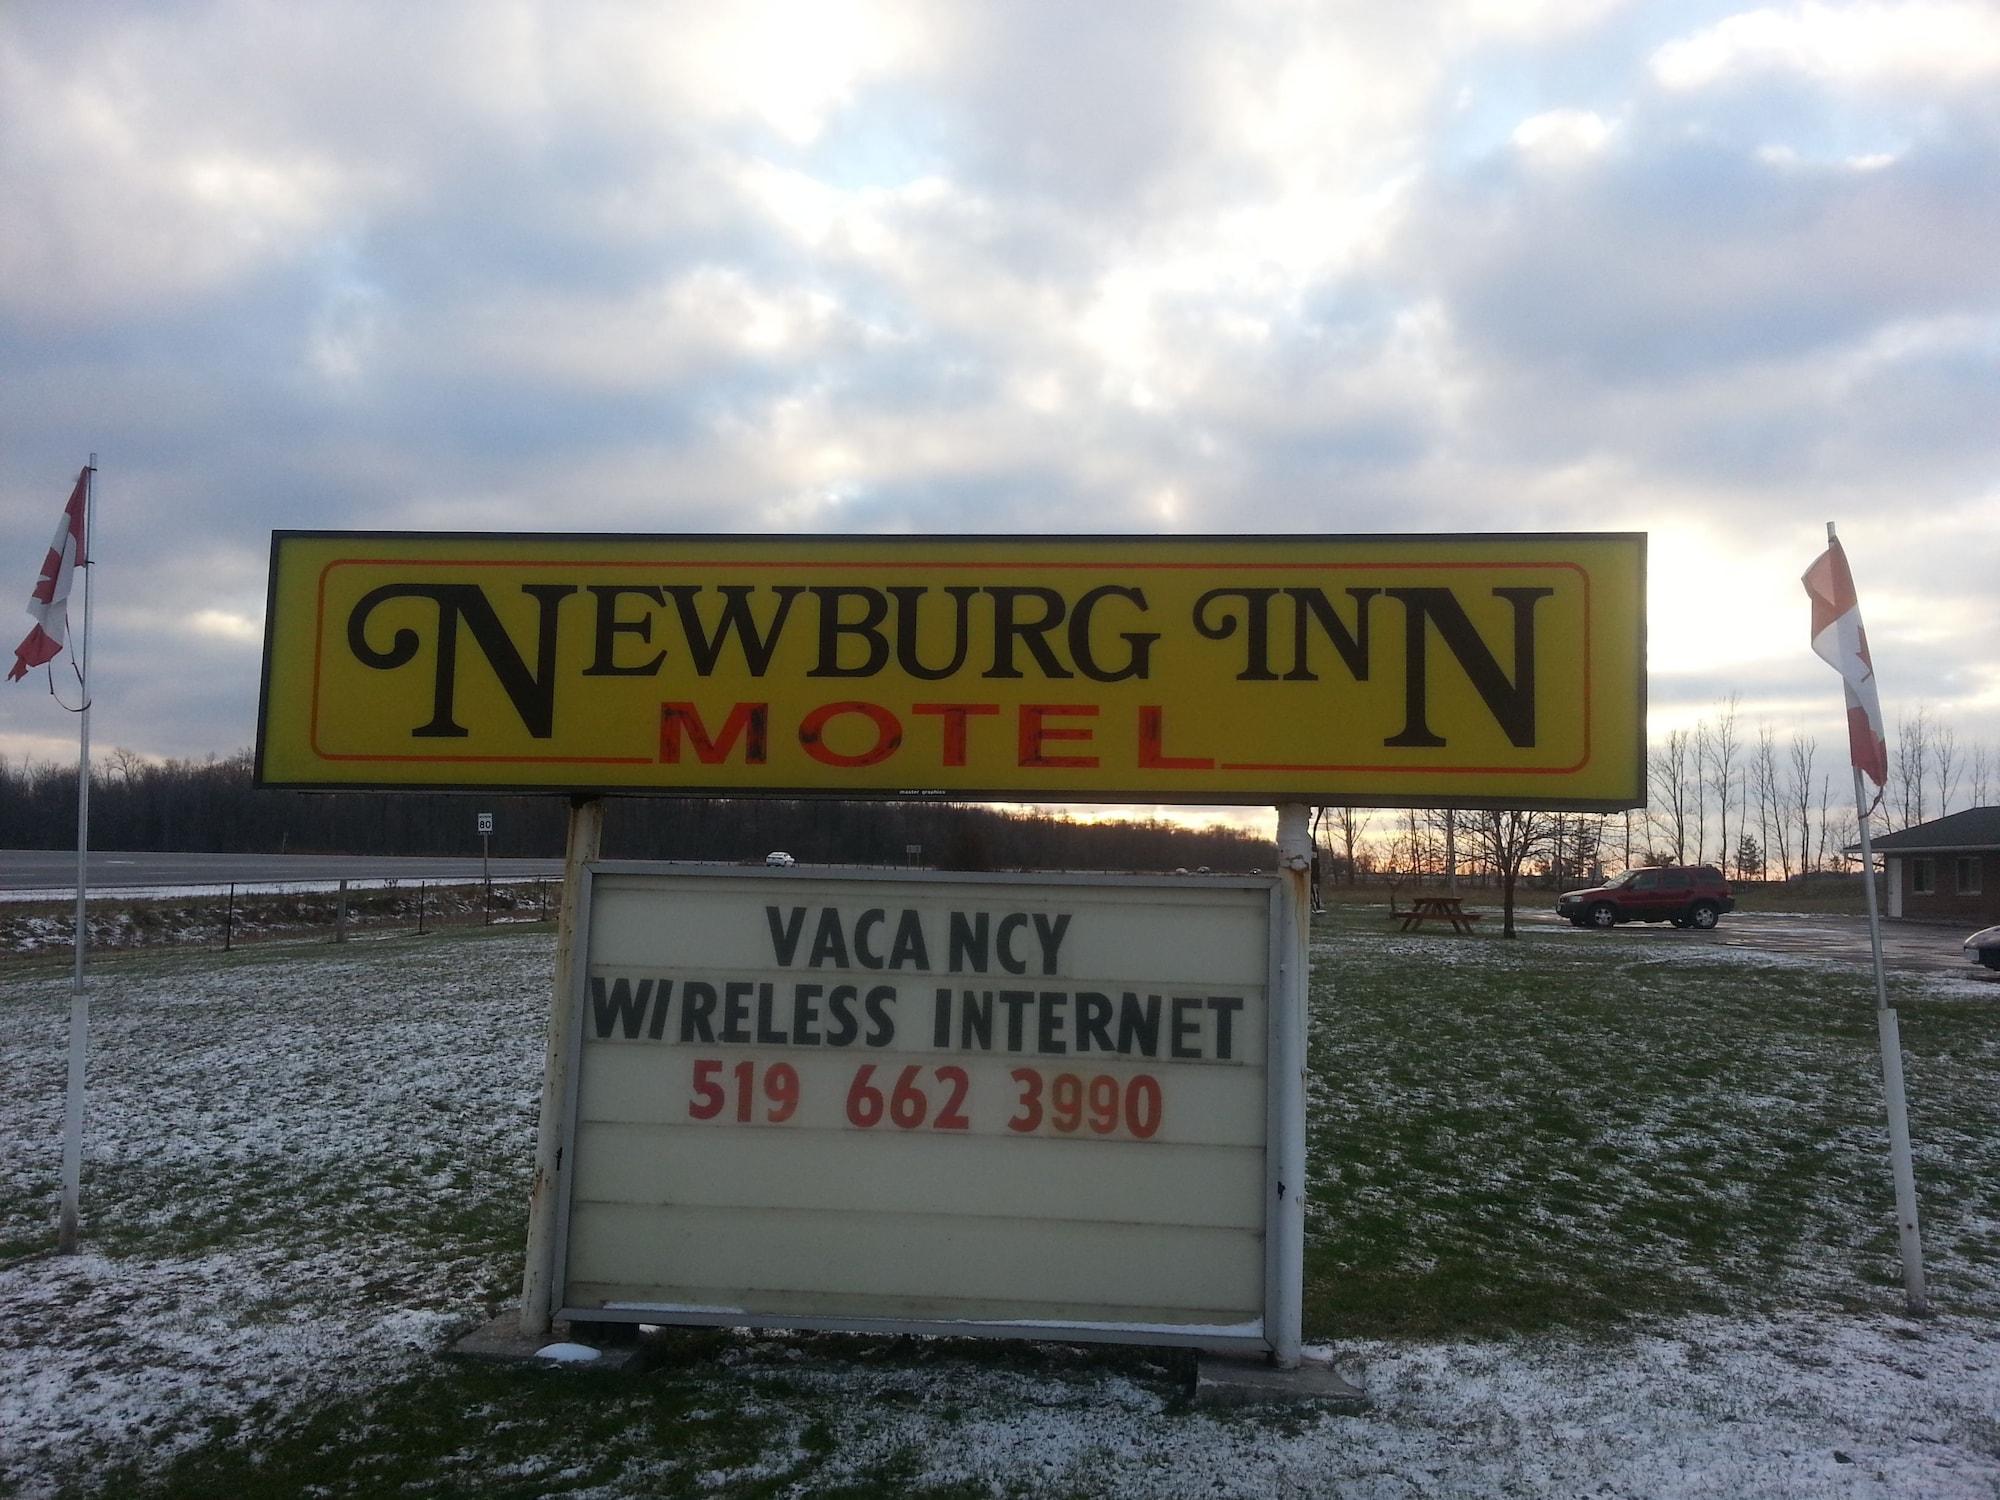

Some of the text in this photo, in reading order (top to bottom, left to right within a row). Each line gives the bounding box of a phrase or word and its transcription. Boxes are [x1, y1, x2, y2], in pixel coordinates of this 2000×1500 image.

[347, 583, 1554, 748] NEWBURG INN
[658, 701, 1215, 769] MOTEL
[766, 906, 1072, 975] VACANCY
[591, 976, 1244, 1060] WIRELESS INTERNET
[689, 1060, 1163, 1140] 519 662 3990
